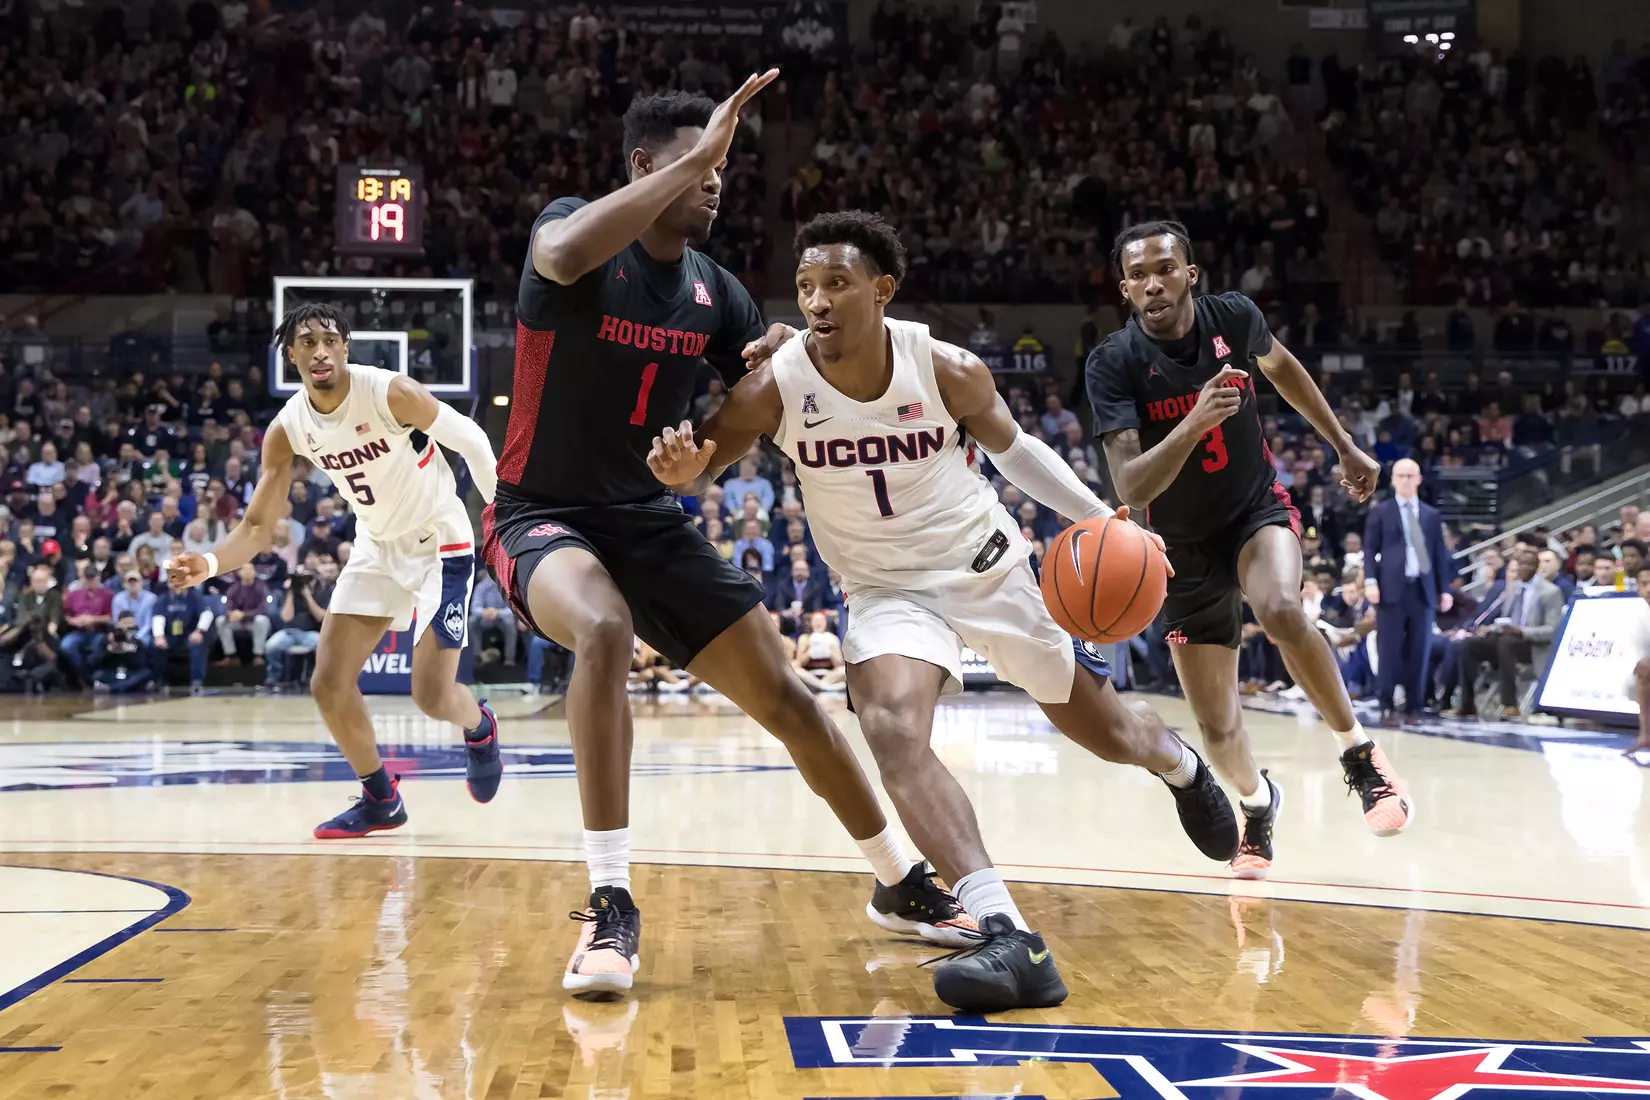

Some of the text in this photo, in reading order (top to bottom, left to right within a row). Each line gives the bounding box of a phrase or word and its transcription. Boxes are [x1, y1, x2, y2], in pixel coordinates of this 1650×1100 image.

[357, 177, 411, 202] 13:19
[370, 202, 404, 242] 19
[597, 315, 711, 357] HOUSTON
[1013, 354, 1046, 371] 116
[1606, 356, 1638, 373] 117
[630, 362, 659, 427] 1
[1146, 376, 1246, 421] HOUN
[796, 426, 945, 469] UCONN
[1200, 423, 1229, 473] 3
[344, 472, 376, 506] 5
[865, 469, 895, 518] 1
